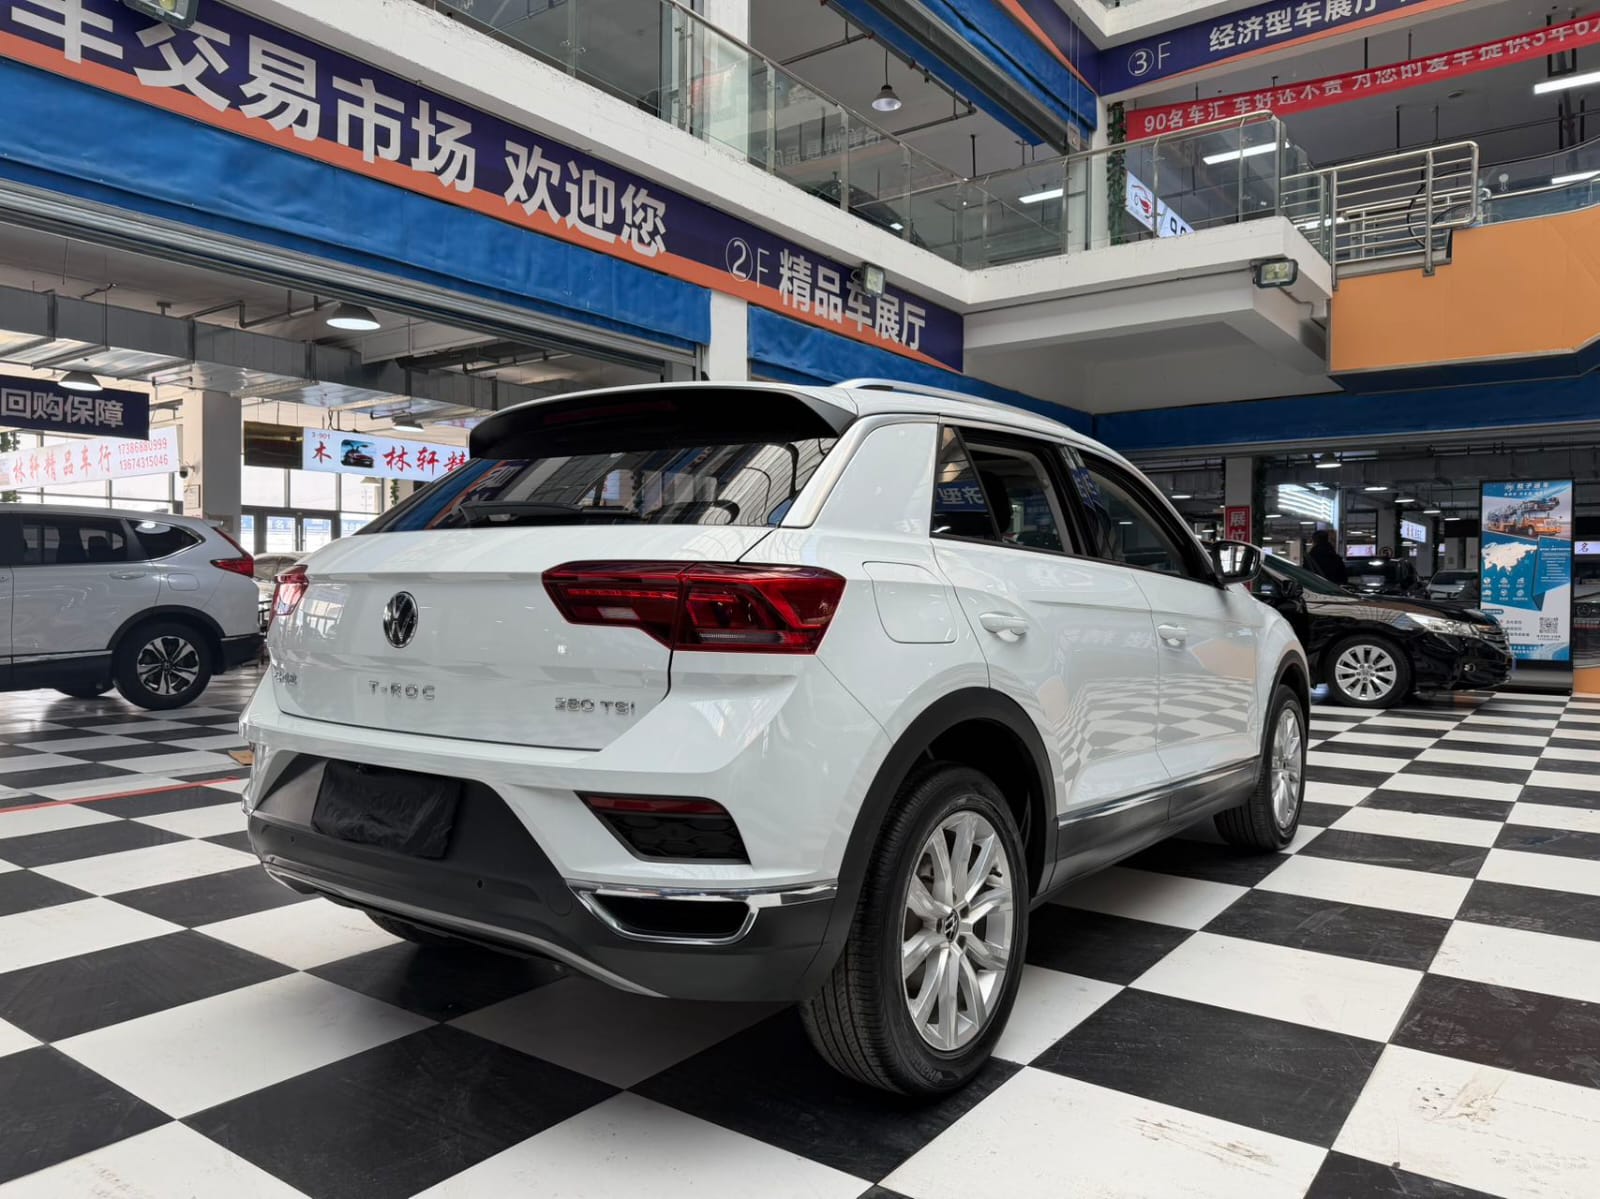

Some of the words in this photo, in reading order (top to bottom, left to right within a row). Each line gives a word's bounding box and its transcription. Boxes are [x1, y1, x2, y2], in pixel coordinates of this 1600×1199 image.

[1144, 101, 1226, 132] 90名车汇
[503, 139, 666, 257] 欢迎您
[779, 248, 926, 350] 精品车展厅
[0, 387, 124, 428] 回购保障
[13, 443, 112, 482] 林轩精品车行
